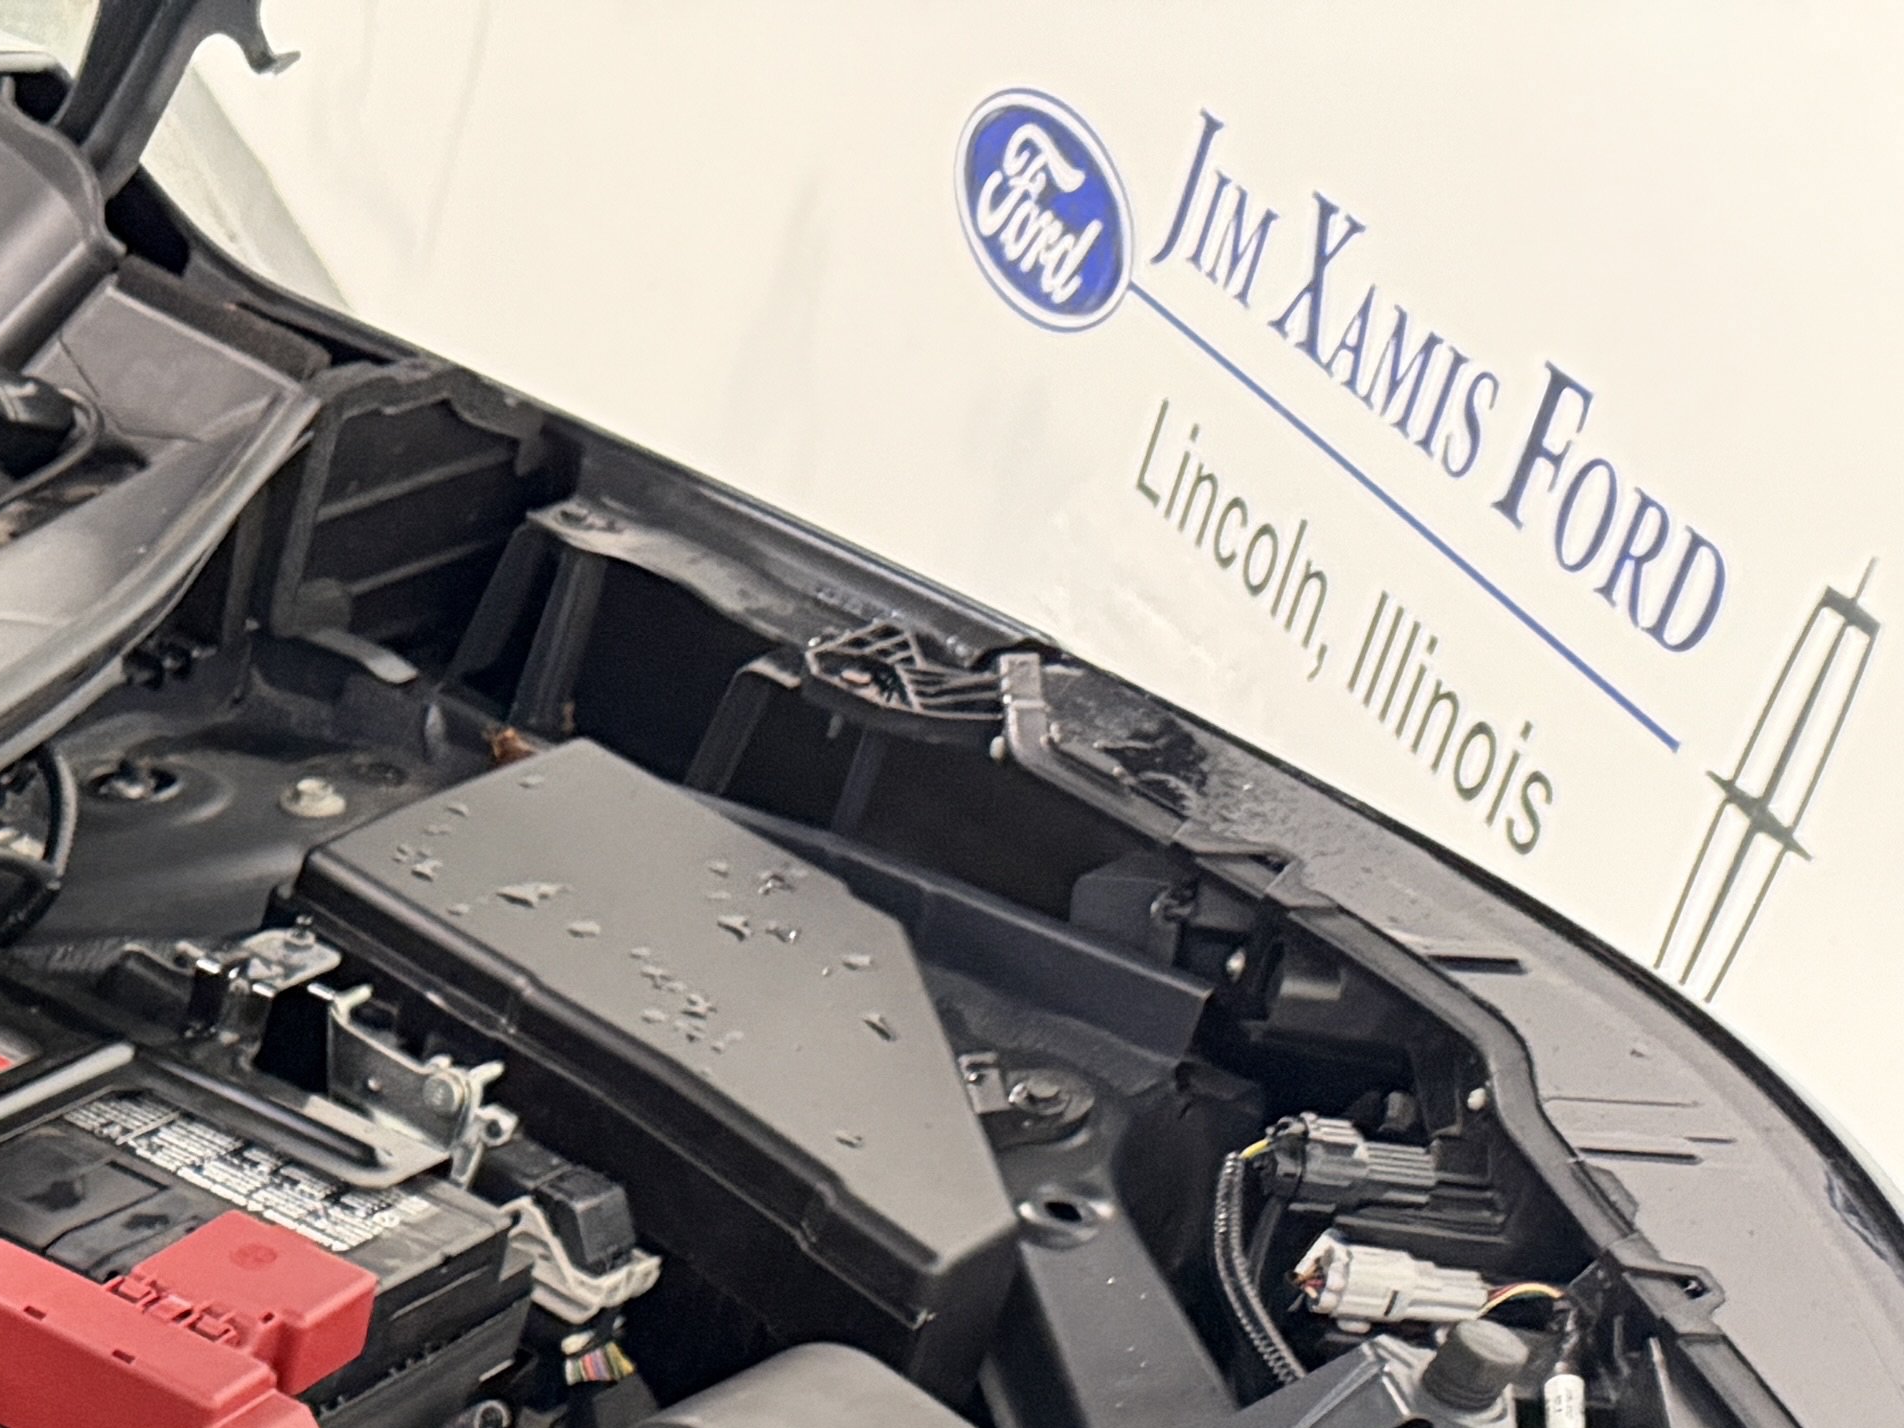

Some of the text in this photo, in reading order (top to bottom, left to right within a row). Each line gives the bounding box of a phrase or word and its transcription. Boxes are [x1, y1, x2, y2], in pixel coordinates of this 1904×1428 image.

[976, 122, 1103, 304] Ford
[1151, 106, 1729, 653] JIM XAMIS FORD
[1134, 398, 1557, 856] Lincoln, Illinois
